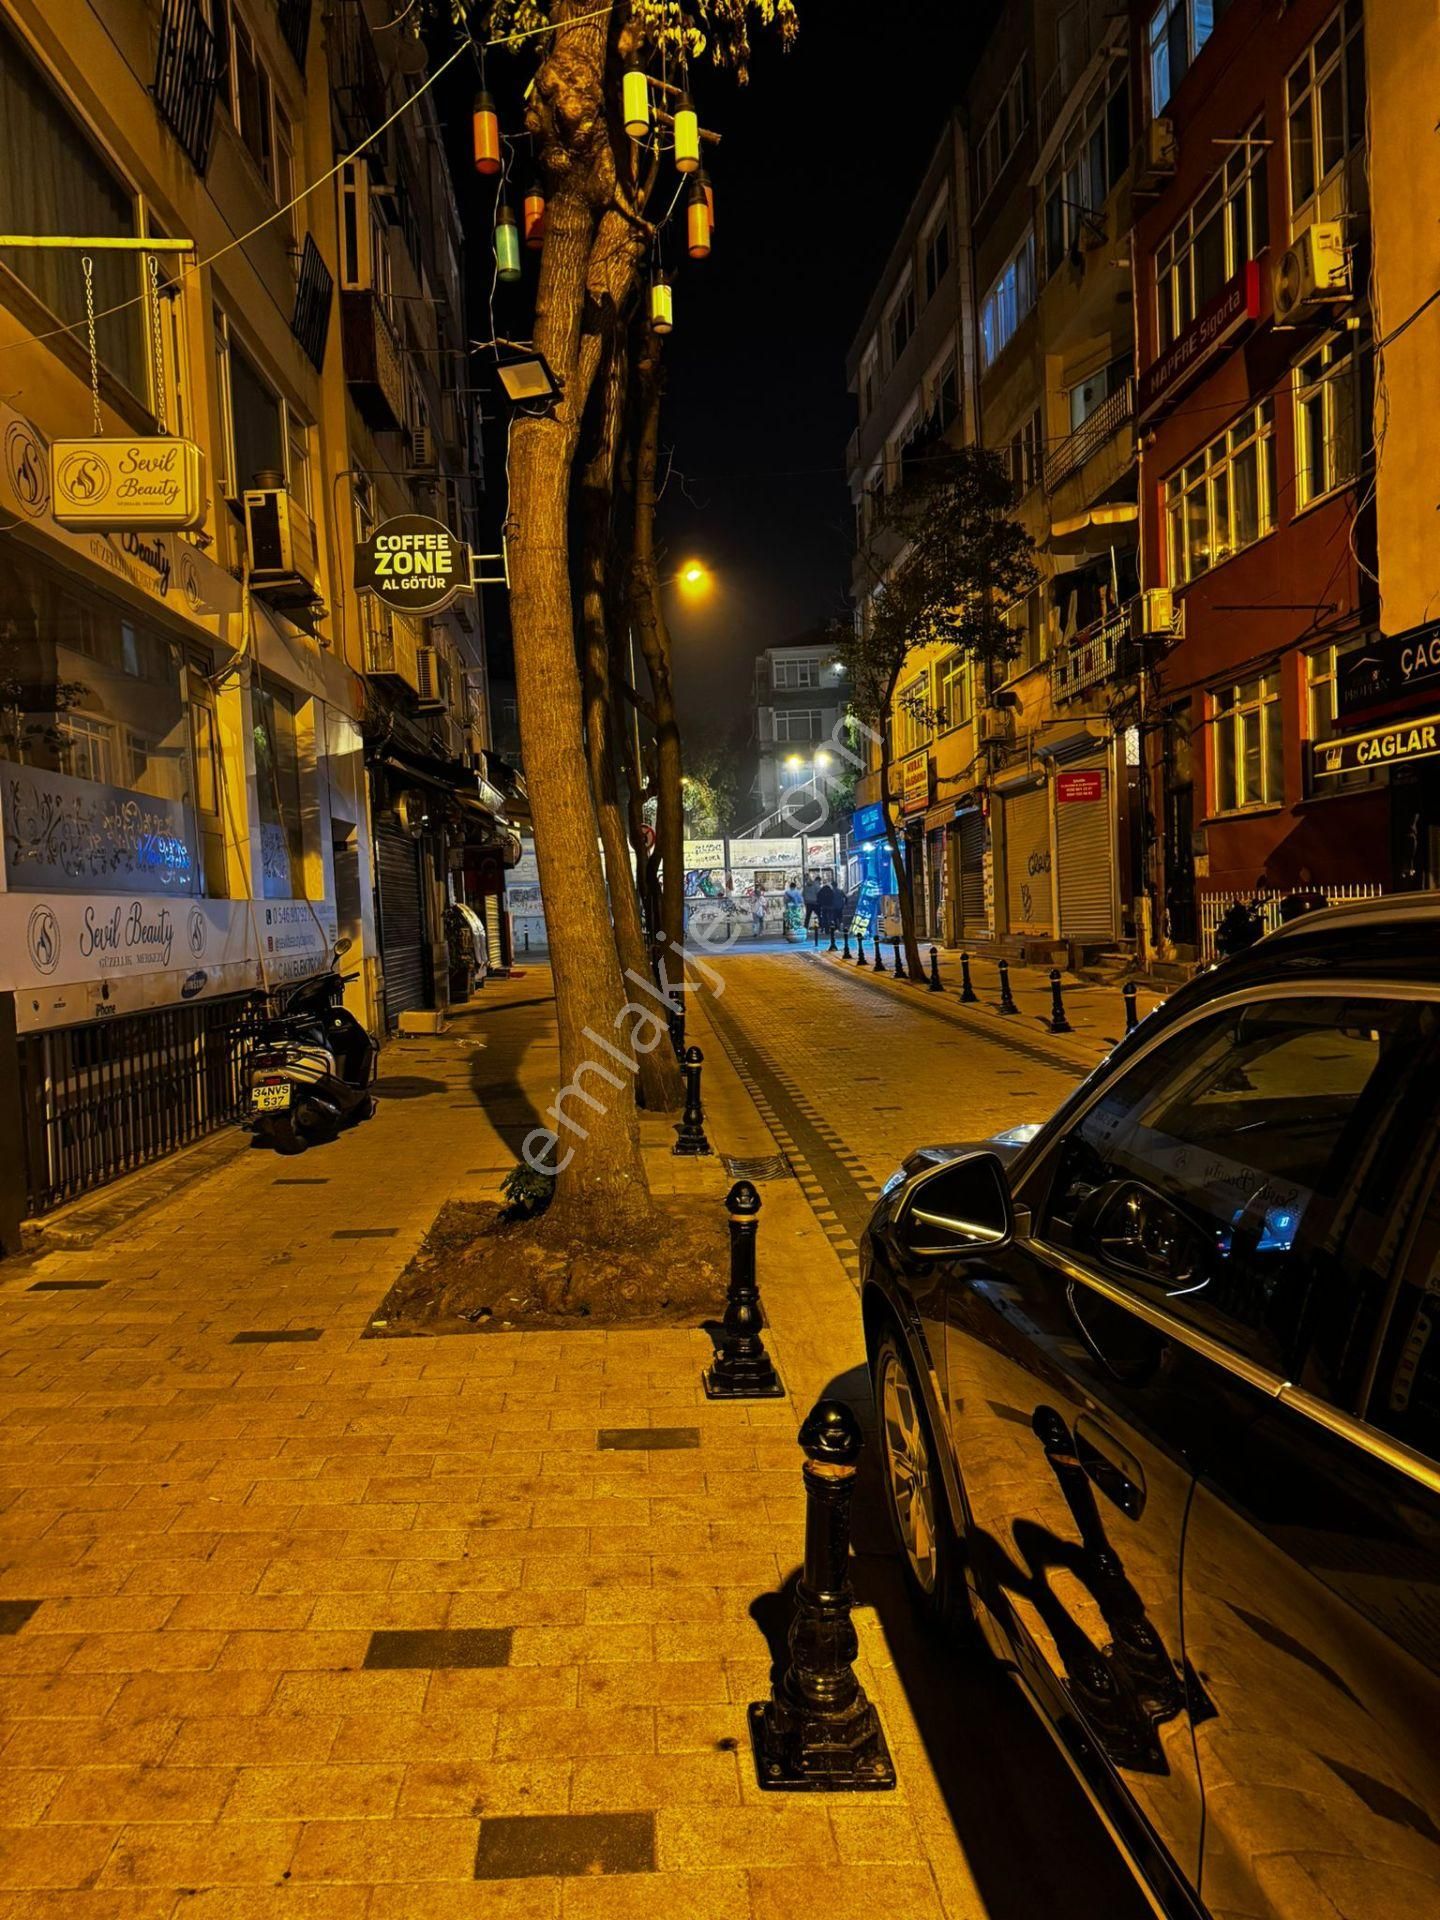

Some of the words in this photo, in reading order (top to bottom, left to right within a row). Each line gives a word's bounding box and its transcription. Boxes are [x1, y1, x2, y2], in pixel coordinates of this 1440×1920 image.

[1151, 332, 1197, 394] MAPFRE
[1200, 291, 1240, 343] Sigorta
[118, 447, 178, 474] Sevil
[116, 477, 180, 506] Beauty
[376, 534, 449, 551] COFFEE
[374, 550, 453, 575] ZONE
[382, 578, 400, 590] AL
[401, 575, 446, 590] GÖTÜR
[80, 906, 121, 957] Sevil
[125, 901, 174, 967] Beauty
[95, 1003, 116, 1016] iPhone
[263, 1096, 285, 1107] 537
